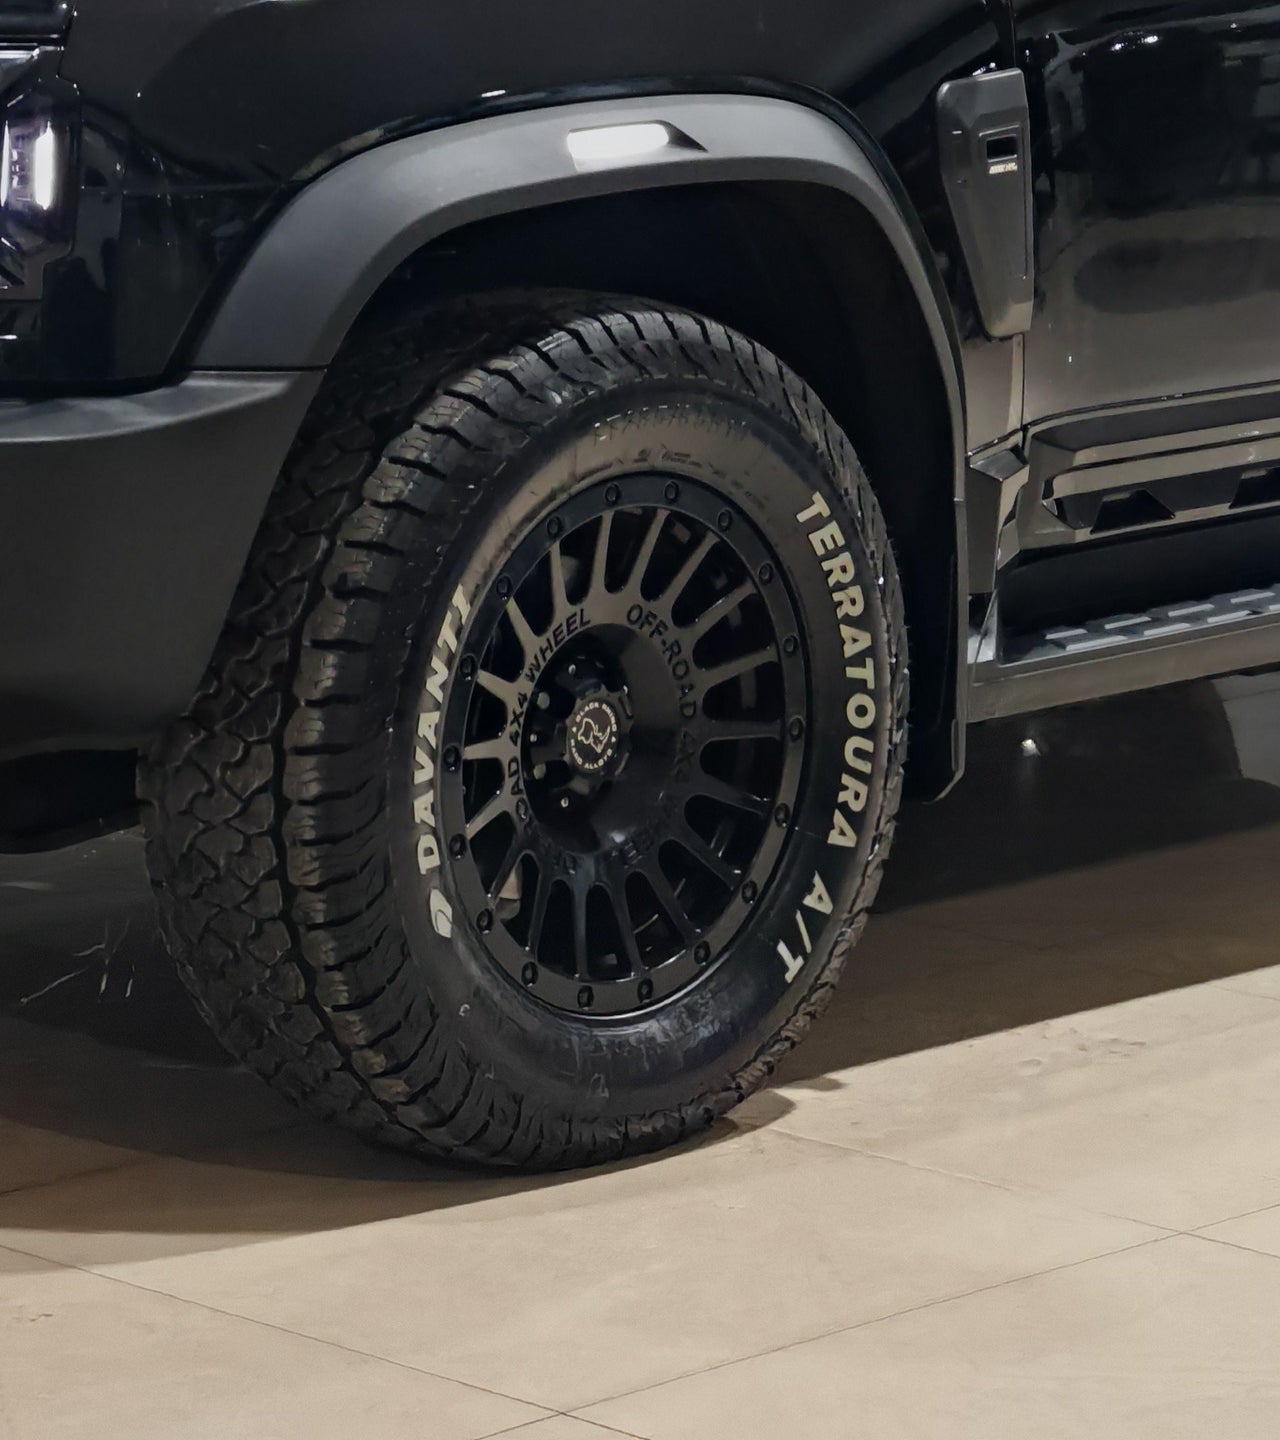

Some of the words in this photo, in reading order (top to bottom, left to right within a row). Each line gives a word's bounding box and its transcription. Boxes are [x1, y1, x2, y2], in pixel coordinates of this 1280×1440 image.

[412, 582, 472, 876] DAVANTI
[524, 608, 592, 684] WHEEL
[625, 603, 697, 719] OFF-ROAD
[795, 490, 877, 849] TERRATOURA
[776, 870, 835, 984] A/T
